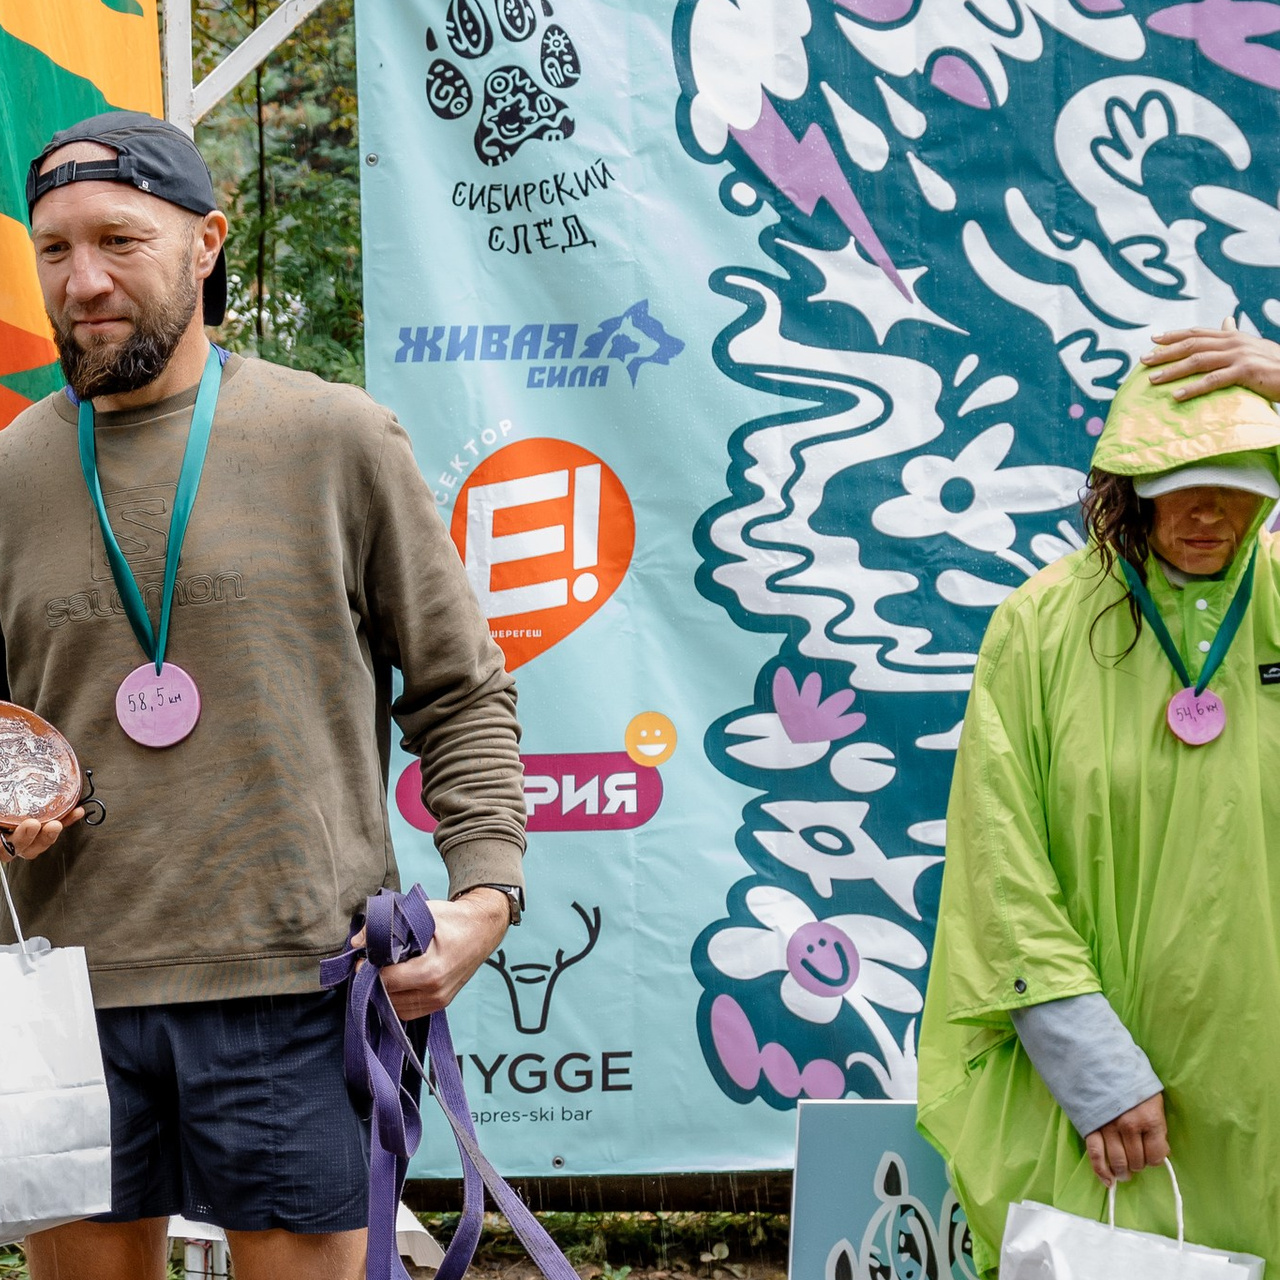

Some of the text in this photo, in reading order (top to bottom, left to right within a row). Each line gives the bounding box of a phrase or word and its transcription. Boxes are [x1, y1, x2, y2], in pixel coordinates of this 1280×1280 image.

[452, 158, 616, 214] СИБИРСКИЙ
[488, 214, 596, 254] СЛЁД
[394, 323, 579, 363] ЖИВАЯ
[526, 365, 610, 389] СИЛА
[433, 419, 513, 506] СЕКТОР
[489, 629, 542, 638] ШЕРЕГЕШ
[127, 687, 182, 713] 58,5 км
[1176, 702, 1219, 722] 54,6 км
[523, 771, 638, 817] РИЯ
[470, 1106, 593, 1125] apres-ski bar
